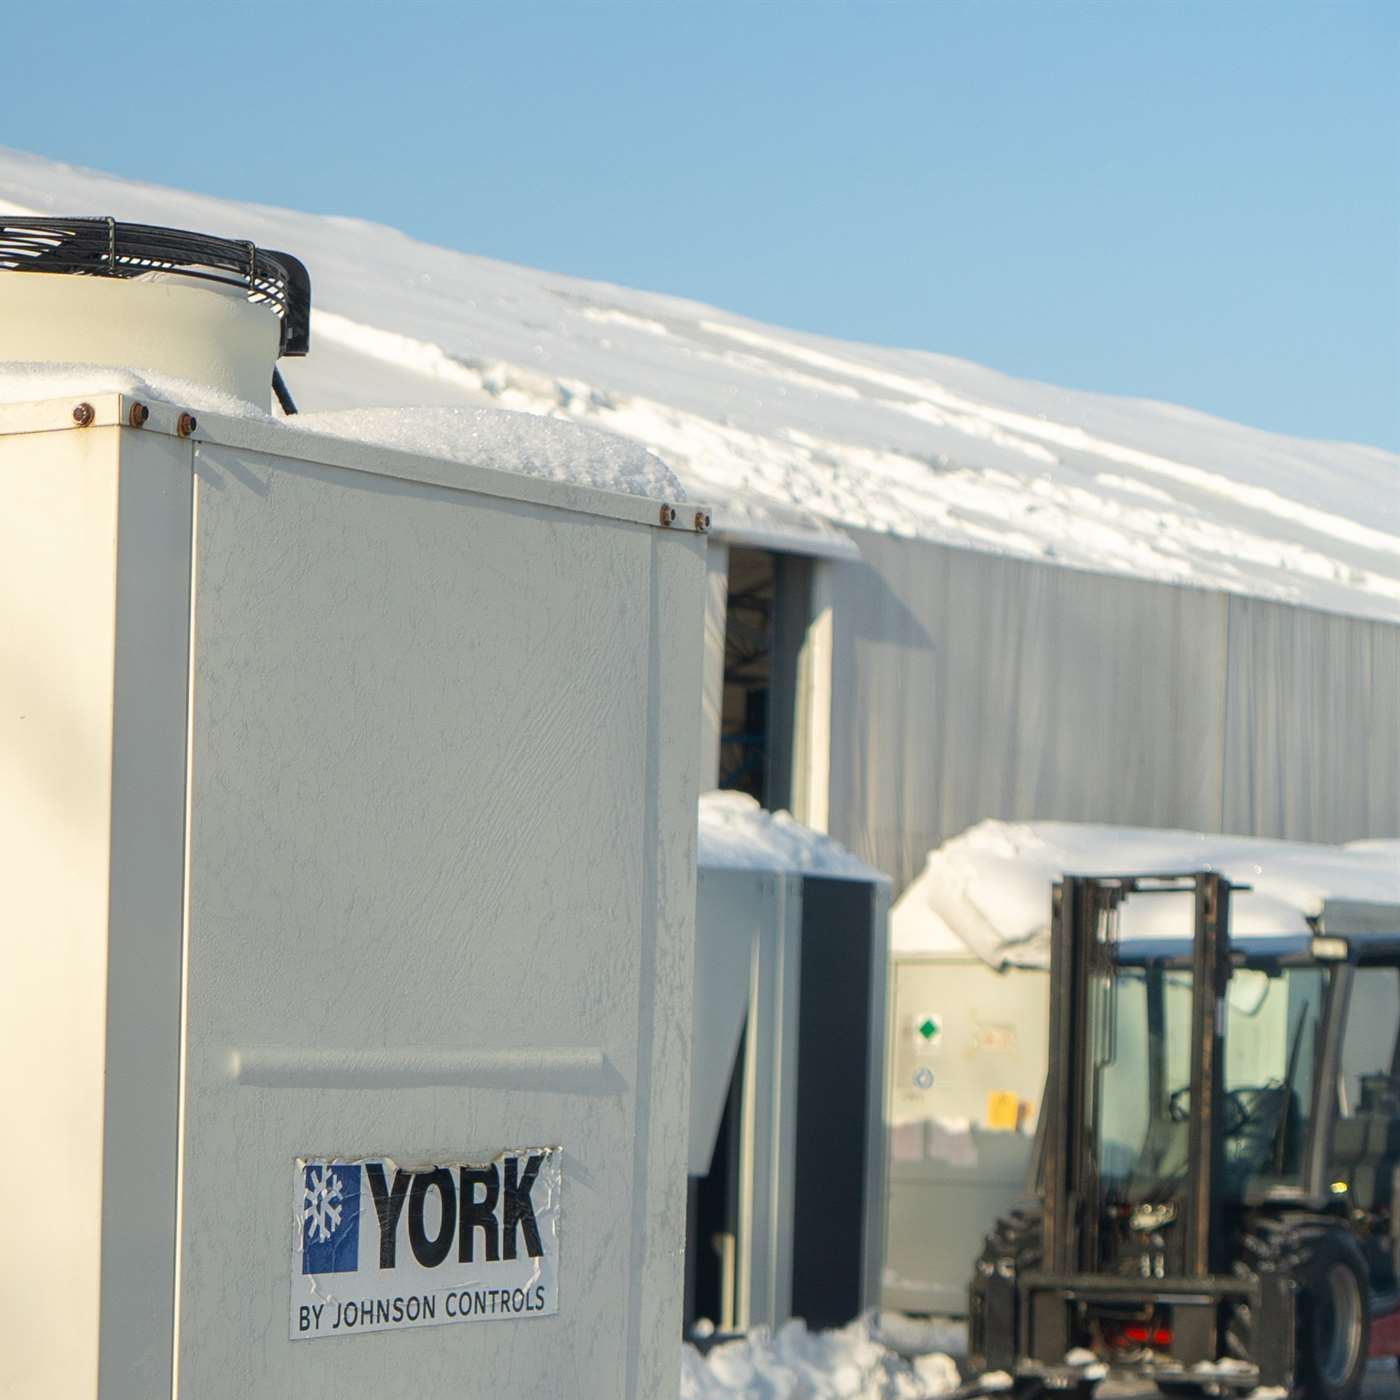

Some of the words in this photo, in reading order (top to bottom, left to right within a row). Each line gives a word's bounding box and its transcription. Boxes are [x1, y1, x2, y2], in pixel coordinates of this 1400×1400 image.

[365, 1156, 545, 1269] YORK
[299, 1304, 324, 1332] BY
[332, 1295, 436, 1330] JOHNSON
[445, 1286, 546, 1318] CONTROLS
